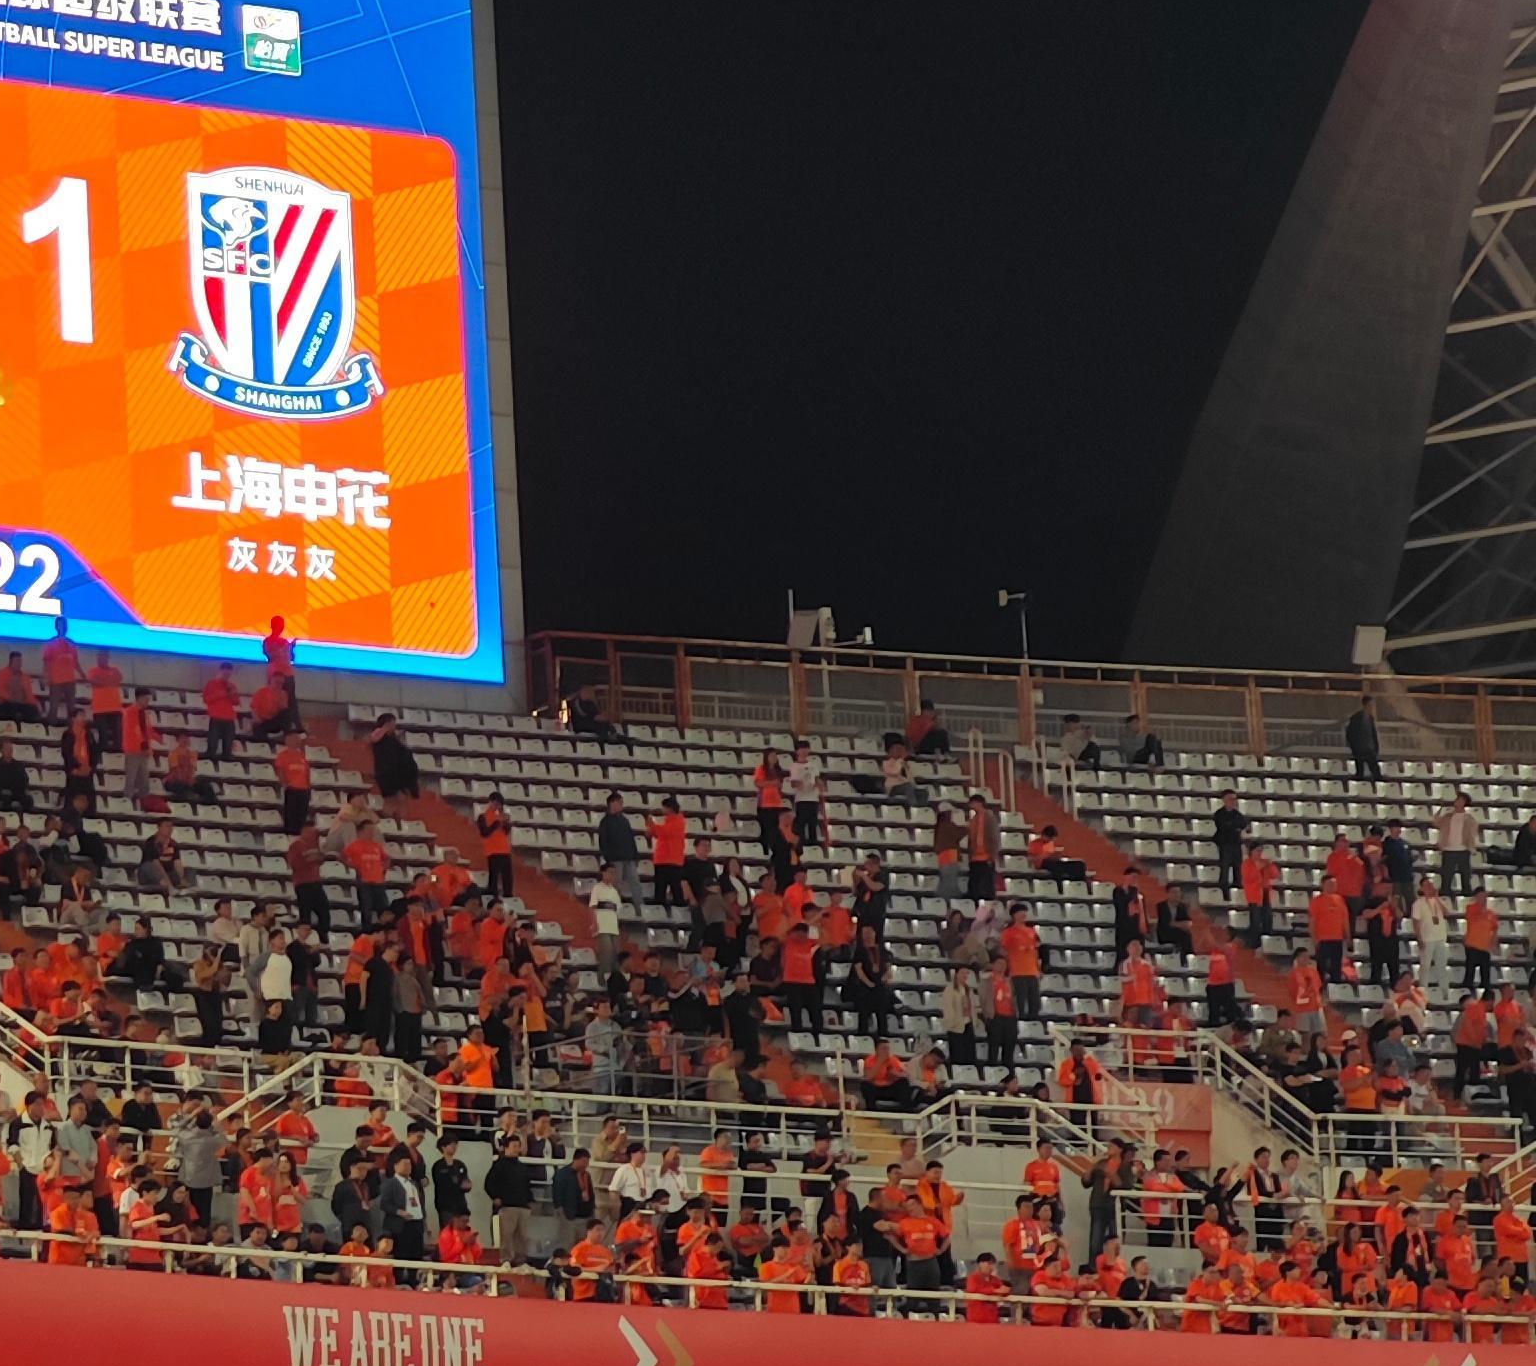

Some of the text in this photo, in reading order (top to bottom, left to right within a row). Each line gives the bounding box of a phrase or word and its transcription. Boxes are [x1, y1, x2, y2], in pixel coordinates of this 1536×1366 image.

[64, 31, 135, 61] SUPER
[139, 42, 224, 72] LEAGUE
[234, 175, 305, 196] SHENHUA
[22, 176, 94, 344] 1
[202, 247, 273, 276] SFC
[234, 385, 323, 411] SHANGHAI
[171, 451, 392, 530] 上海申花
